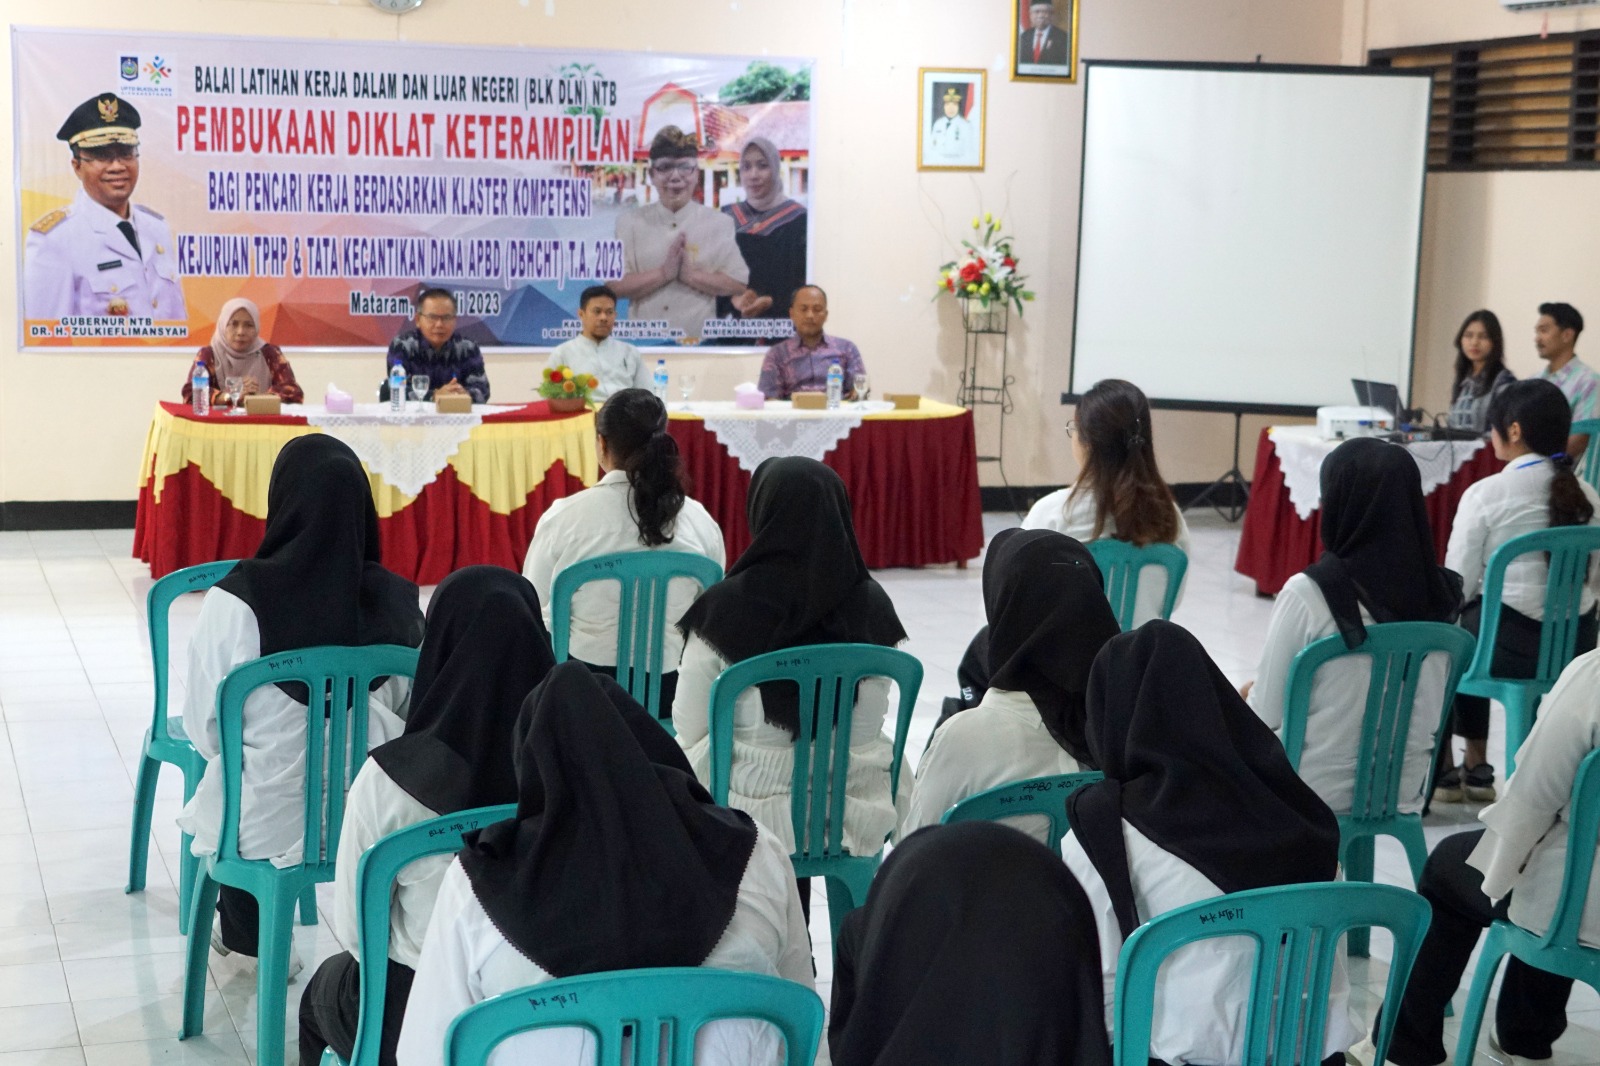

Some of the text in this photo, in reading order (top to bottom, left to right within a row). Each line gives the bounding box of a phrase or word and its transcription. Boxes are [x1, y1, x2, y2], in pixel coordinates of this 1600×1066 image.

[195, 66, 617, 112] BALAI LATIHAN KERJA DALAM DAN LUAR NEGERI (BLK DLN) NTB
[177, 105, 630, 162] PEMBUKAAN DIKLAT KETERAMPILAN
[208, 171, 591, 218] BAGI PENCARI KERJA BERDASARKAN KLASTER KOMPETENSI
[178, 235, 623, 289] KEJURUAN TPHP & TATA KECANTIKAN DANA APBD (DBHCHT) T.A. 2023
[351, 292, 414, 318] Mataram,
[468, 292, 500, 315] 2023
[61, 317, 152, 326] GUBERNUR NTB
[650, 321, 668, 329] NTB
[705, 320, 737, 328] KEPALA
[31, 327, 187, 336] DR. H. ZULKIEFLIMANSYAH
[550, 330, 572, 338] GEDE
